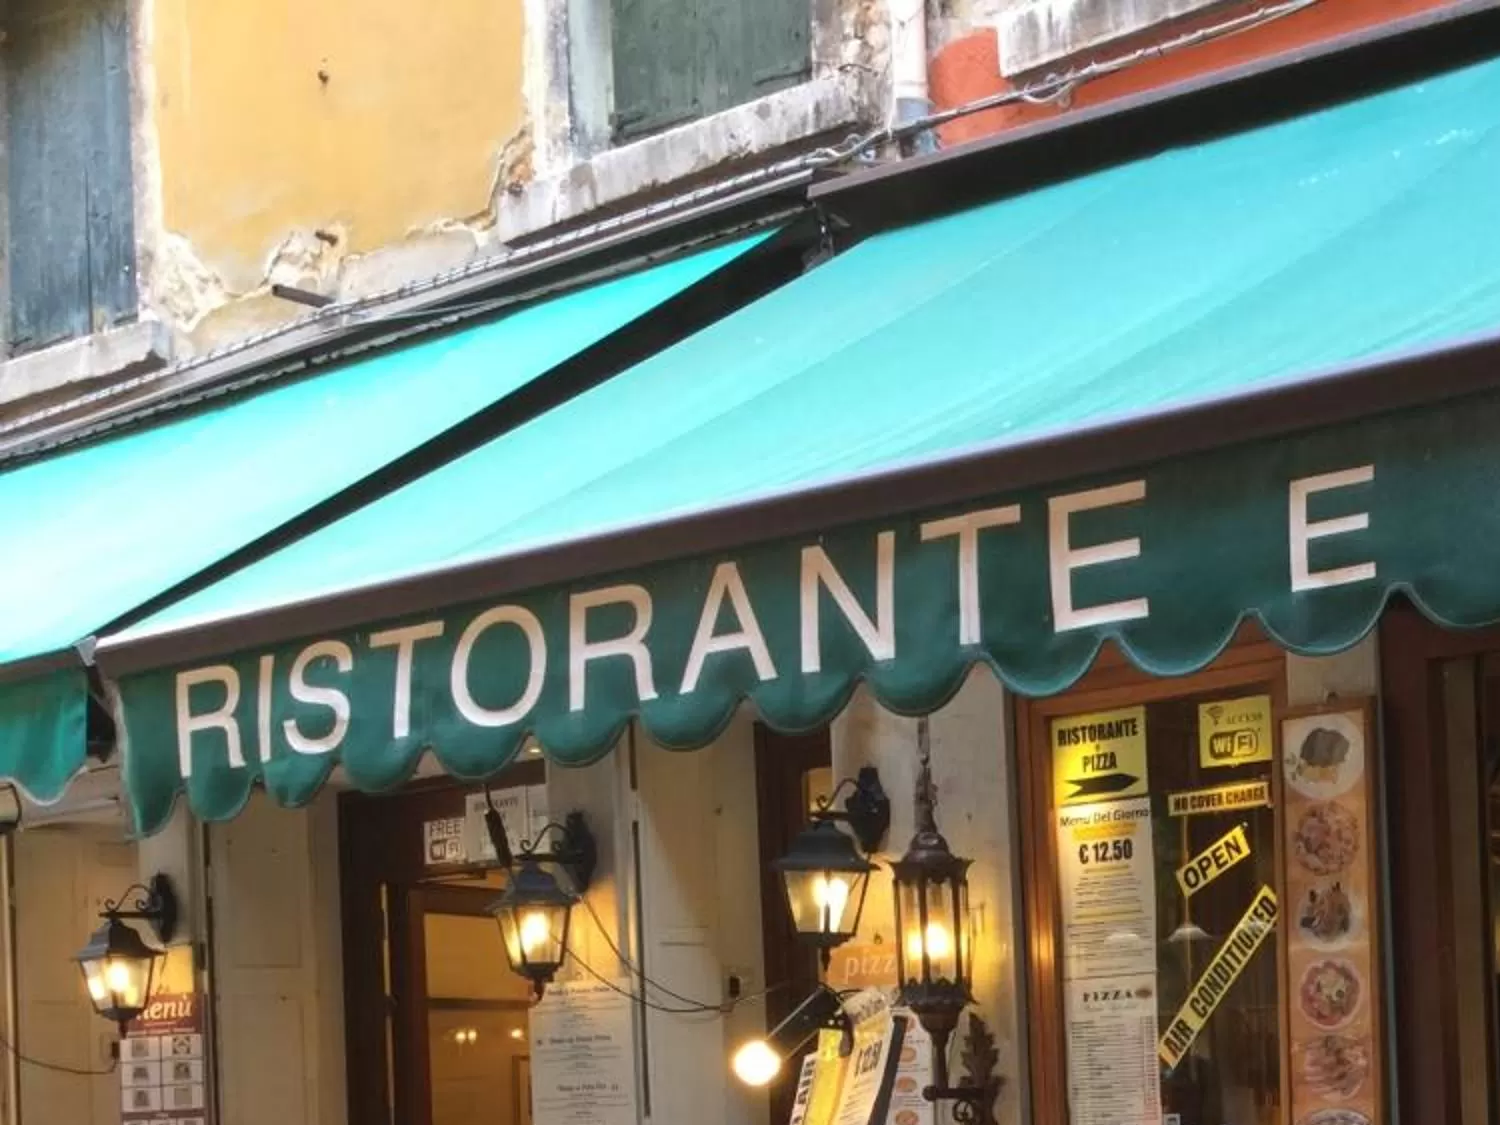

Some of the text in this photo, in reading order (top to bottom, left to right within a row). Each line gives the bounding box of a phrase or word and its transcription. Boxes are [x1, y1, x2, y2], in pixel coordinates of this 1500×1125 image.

[175, 478, 1150, 778] RISTORANTE
[1289, 464, 1377, 593] E
[1058, 718, 1139, 747] RISTORANTE
[1083, 751, 1117, 773] PIZZA
[1092, 838, 1133, 864] 12.50
[1184, 836, 1242, 889] OPEN
[845, 954, 898, 984] pizz
[1164, 895, 1277, 1061] AIR CONDITIONED
[136, 994, 193, 1020] enù
